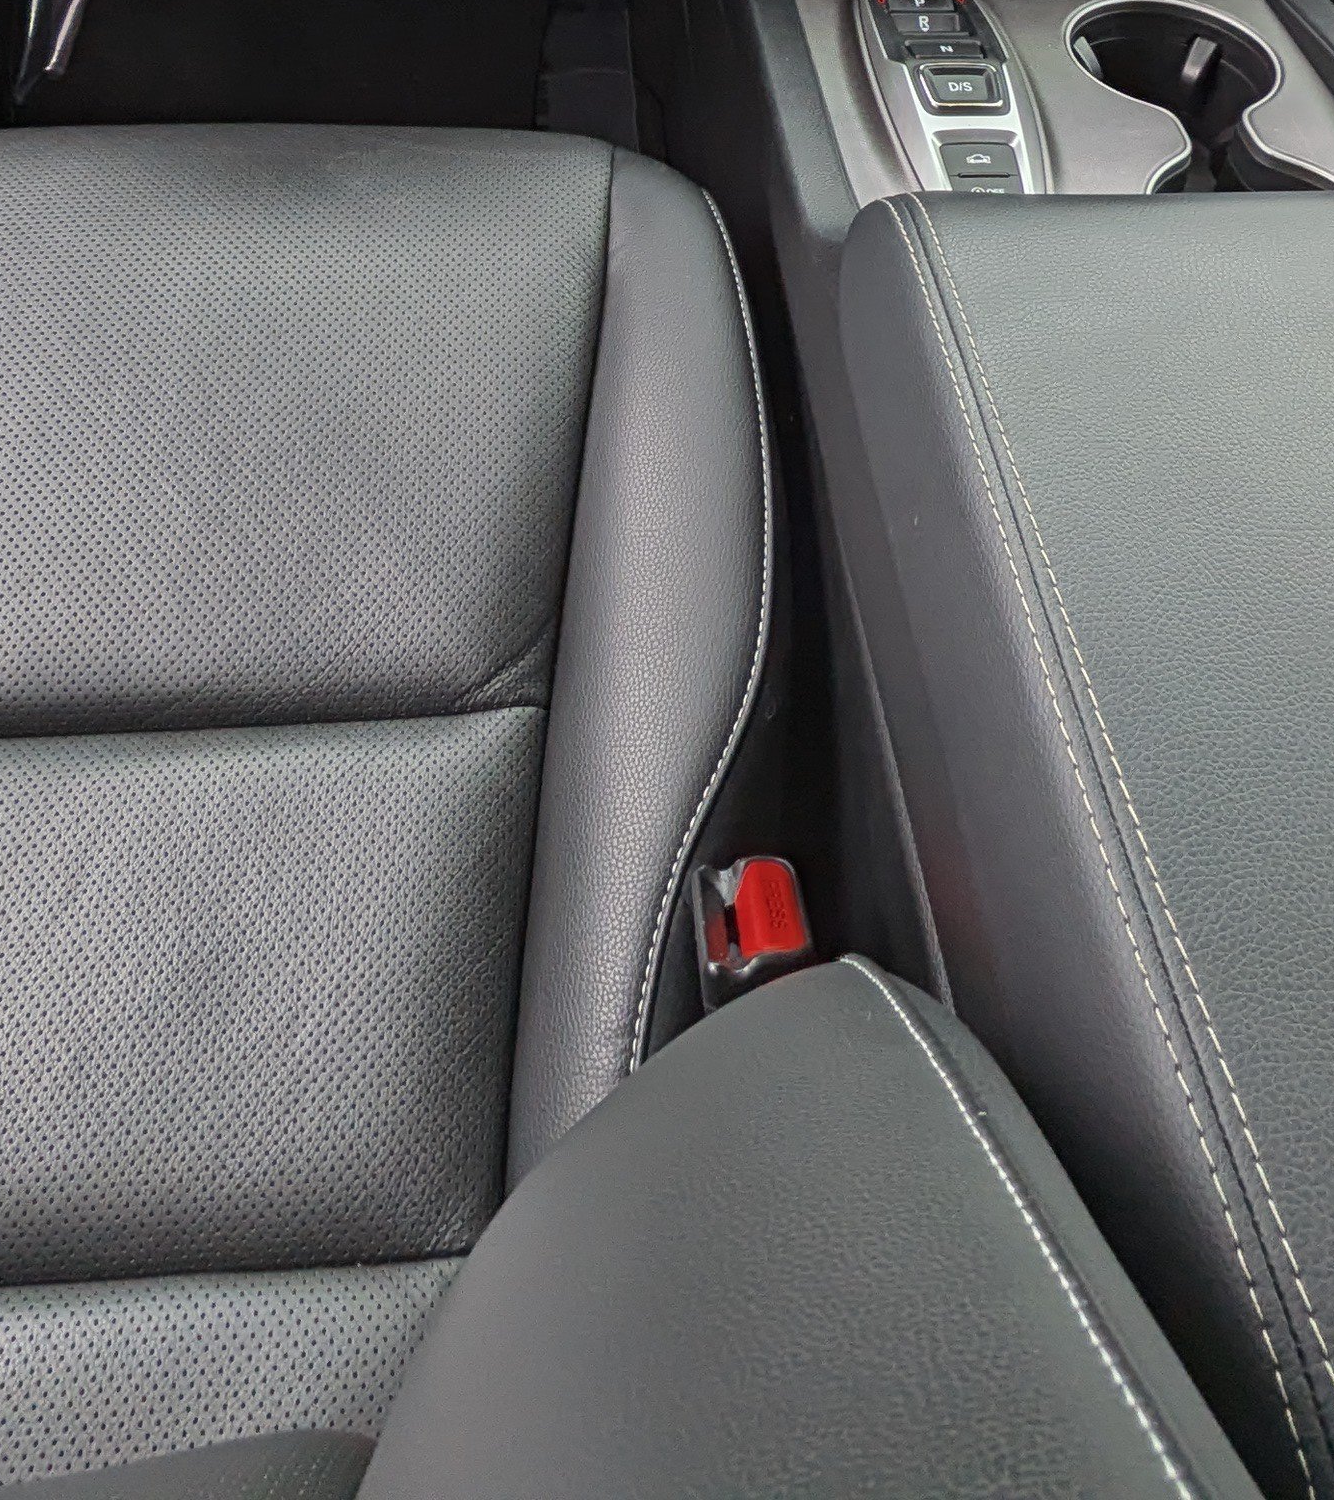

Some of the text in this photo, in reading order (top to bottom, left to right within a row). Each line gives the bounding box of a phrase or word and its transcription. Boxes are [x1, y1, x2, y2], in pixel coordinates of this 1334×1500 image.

[919, 15, 929, 28] R
[940, 45, 954, 53] N
[948, 81, 973, 93] D/S
